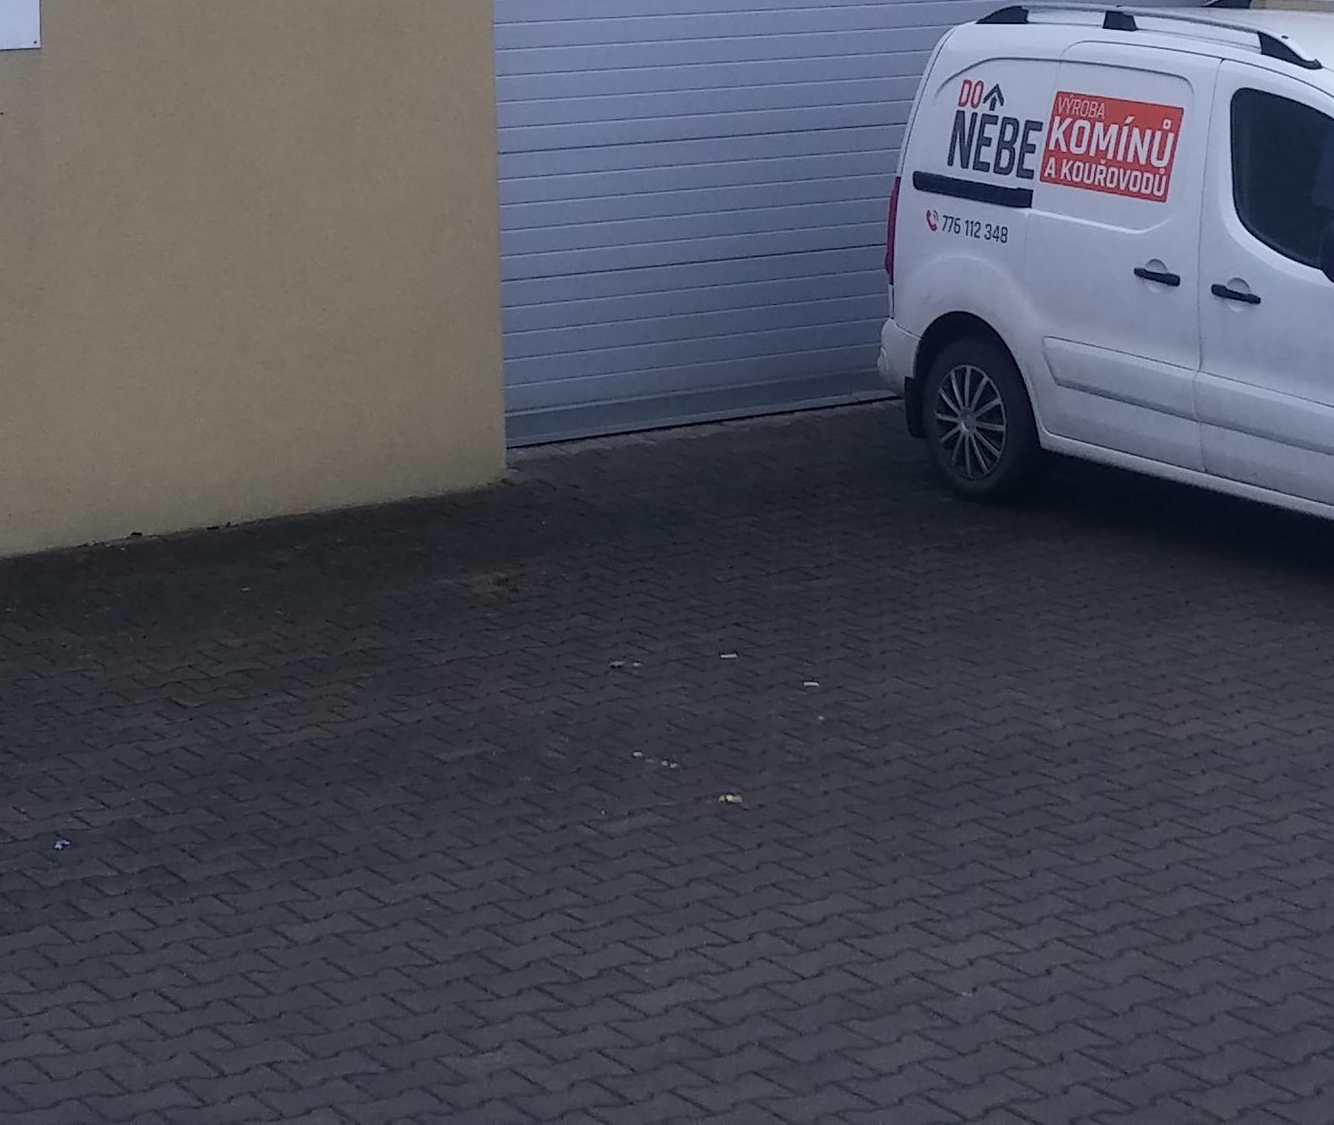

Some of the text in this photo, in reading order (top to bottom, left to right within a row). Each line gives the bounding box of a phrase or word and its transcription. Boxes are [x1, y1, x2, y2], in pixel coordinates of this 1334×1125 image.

[958, 79, 985, 109] DO
[1058, 94, 1106, 120] VÝROBA
[947, 109, 1044, 181] NEBE
[1048, 115, 1175, 168] KOMÍNŮ
[1044, 156, 1168, 197] A KOUŘOVODŮ
[964, 219, 982, 240] 112
[983, 223, 1009, 244] 348
